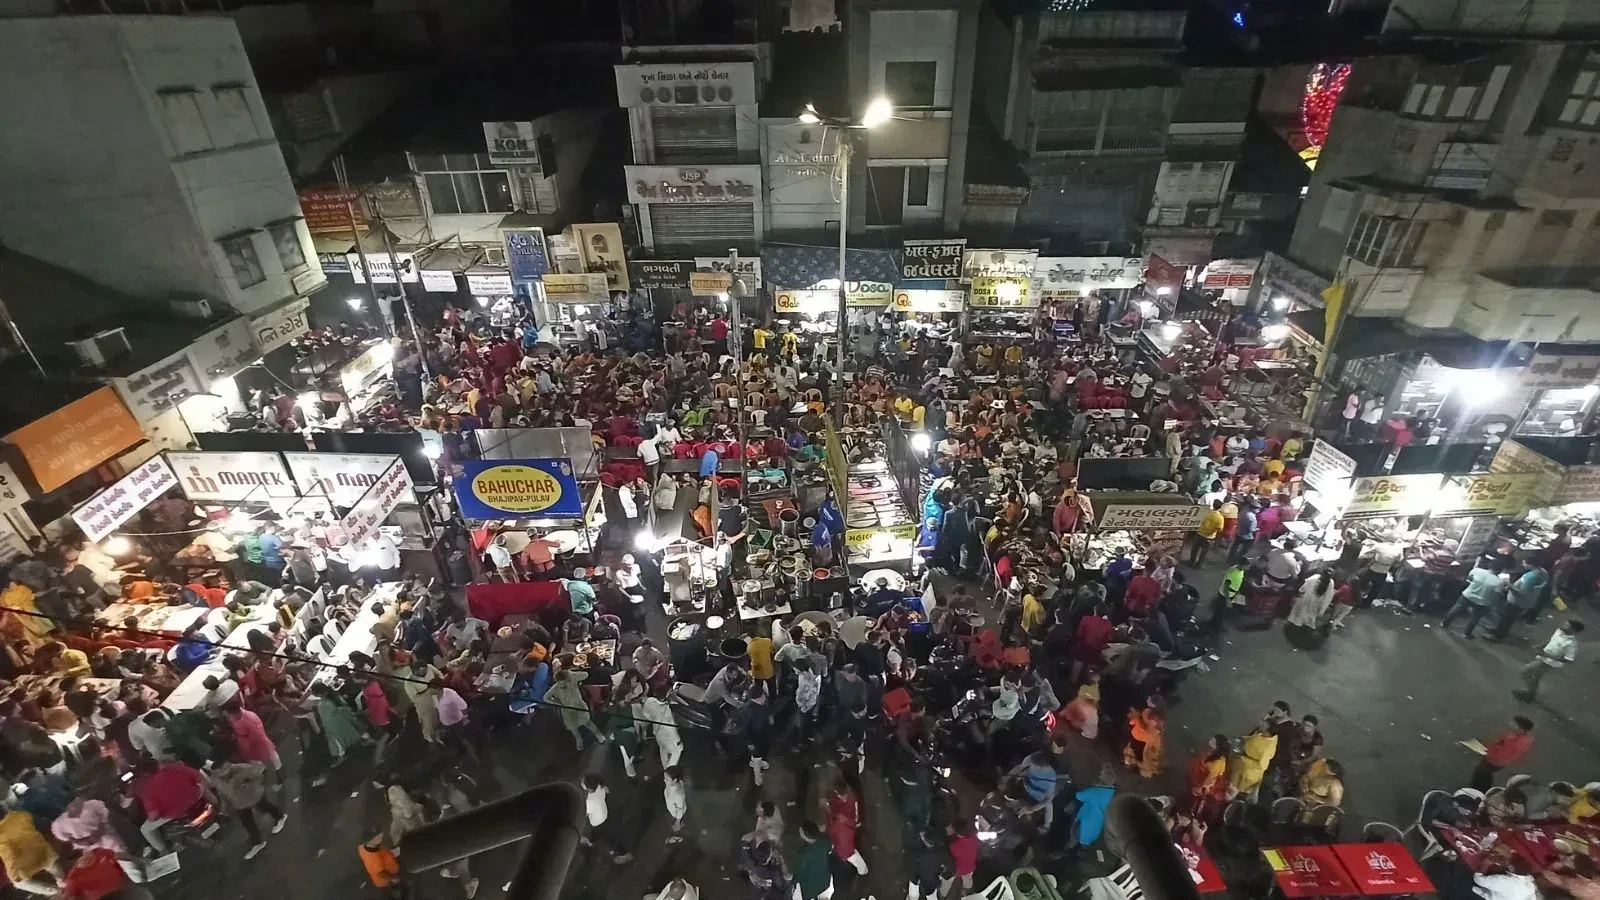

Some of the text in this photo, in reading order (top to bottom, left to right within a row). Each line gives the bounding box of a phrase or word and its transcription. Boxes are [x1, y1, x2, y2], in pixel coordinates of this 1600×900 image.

[681, 172, 701, 180] JSP
[642, 262, 681, 273] ભગવતી
[903, 257, 961, 278] જવેલર્સ
[848, 280, 889, 294] Dosa
[217, 471, 285, 486] MANEK
[477, 479, 555, 494] BAHUCHAR
[487, 494, 550, 503] BHAJIPAV-PULAV
[1117, 506, 1200, 518] મહાલક્ષ્મી
[1150, 517, 1173, 526] એન્ડ
